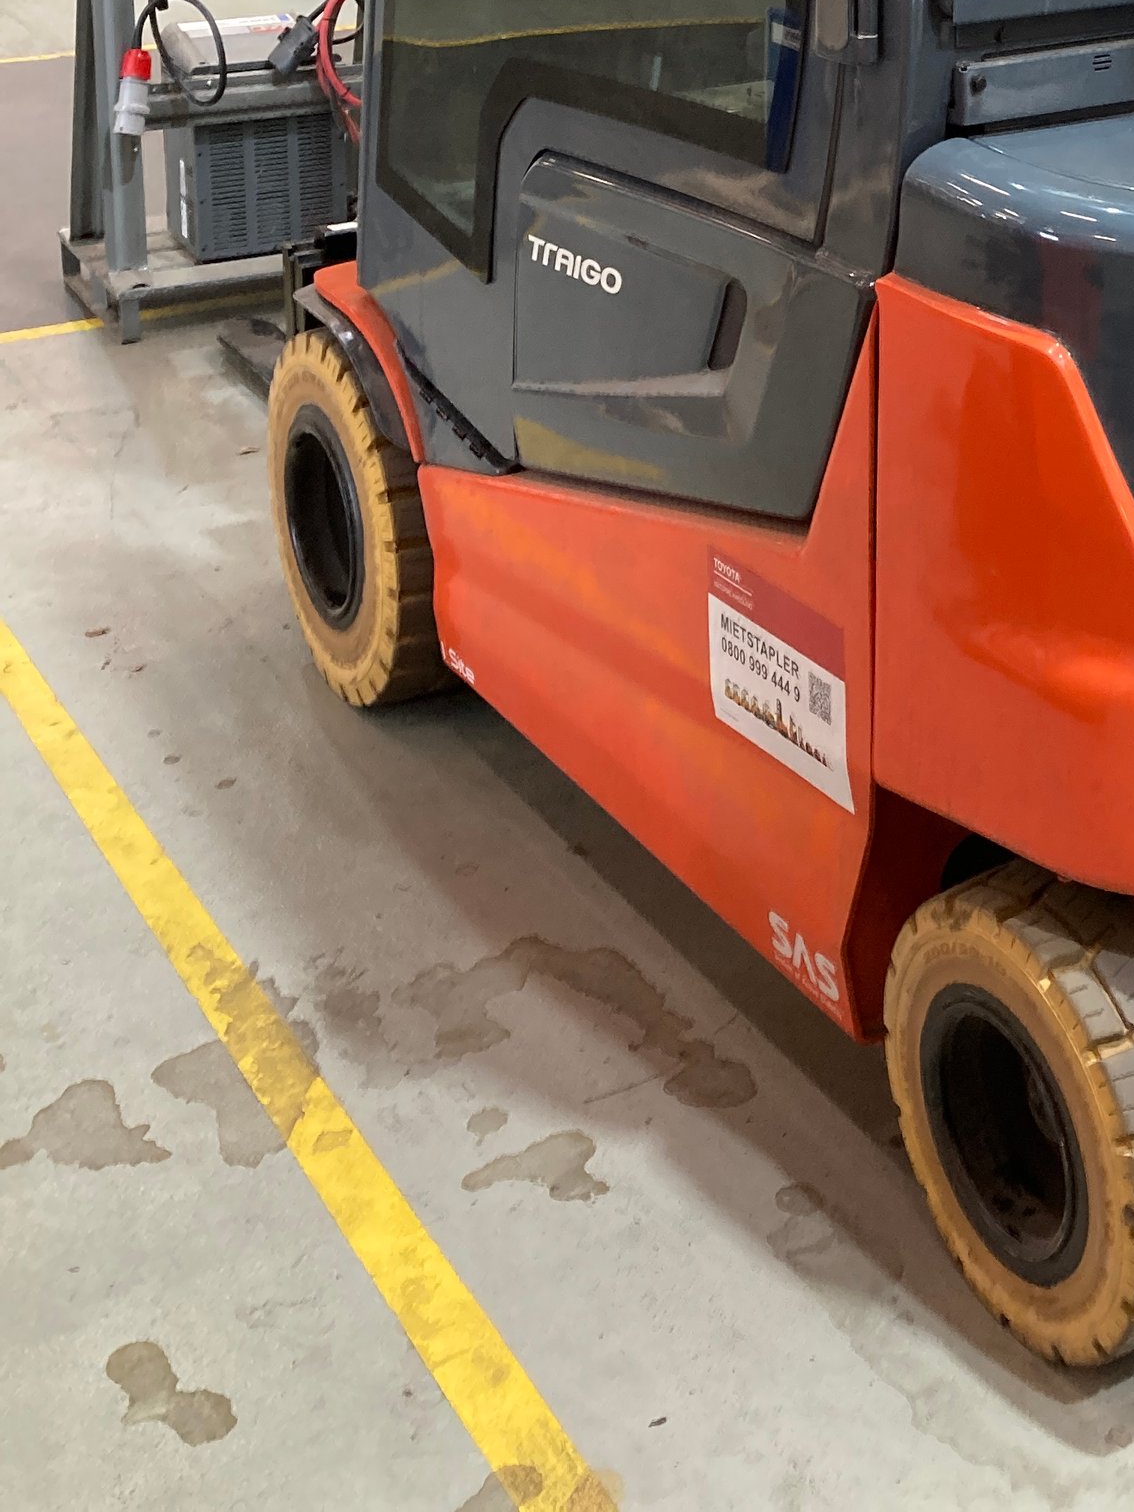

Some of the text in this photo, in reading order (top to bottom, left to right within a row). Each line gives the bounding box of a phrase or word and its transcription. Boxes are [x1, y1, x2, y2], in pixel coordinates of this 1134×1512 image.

[528, 234, 622, 294] TRAIGO
[713, 557, 741, 584] TOYOTA
[721, 613, 800, 680] MIETSTAPLER
[721, 636, 800, 703] 0800 999 444 9
[768, 911, 839, 1002] SAS
